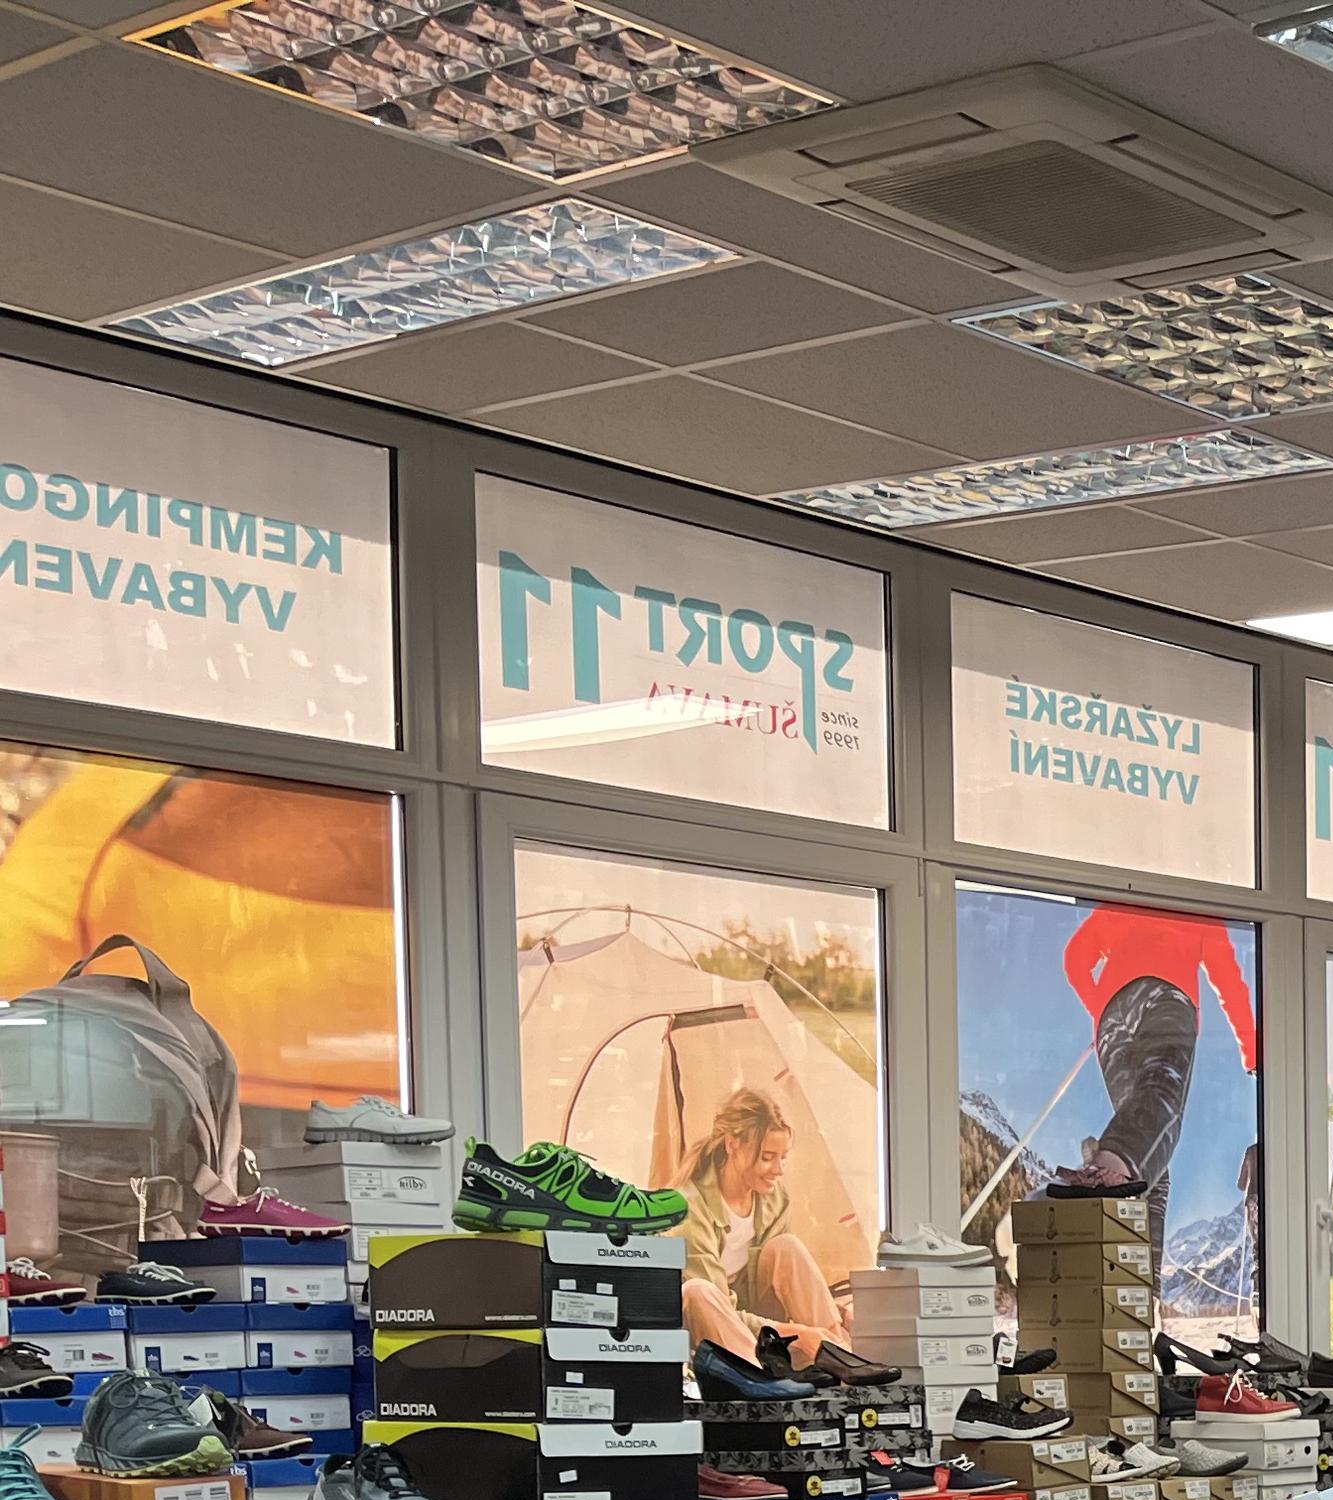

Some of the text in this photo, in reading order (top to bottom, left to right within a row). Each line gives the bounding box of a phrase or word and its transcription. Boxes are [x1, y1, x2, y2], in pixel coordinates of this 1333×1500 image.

[467, 1161, 536, 1200] DIADORA
[597, 1248, 651, 1260] DIADORA
[375, 1309, 435, 1323] DIADORA
[598, 1343, 652, 1354] DIADORA
[380, 1402, 437, 1417] DIADORA
[605, 1439, 657, 1450] DIADORA
